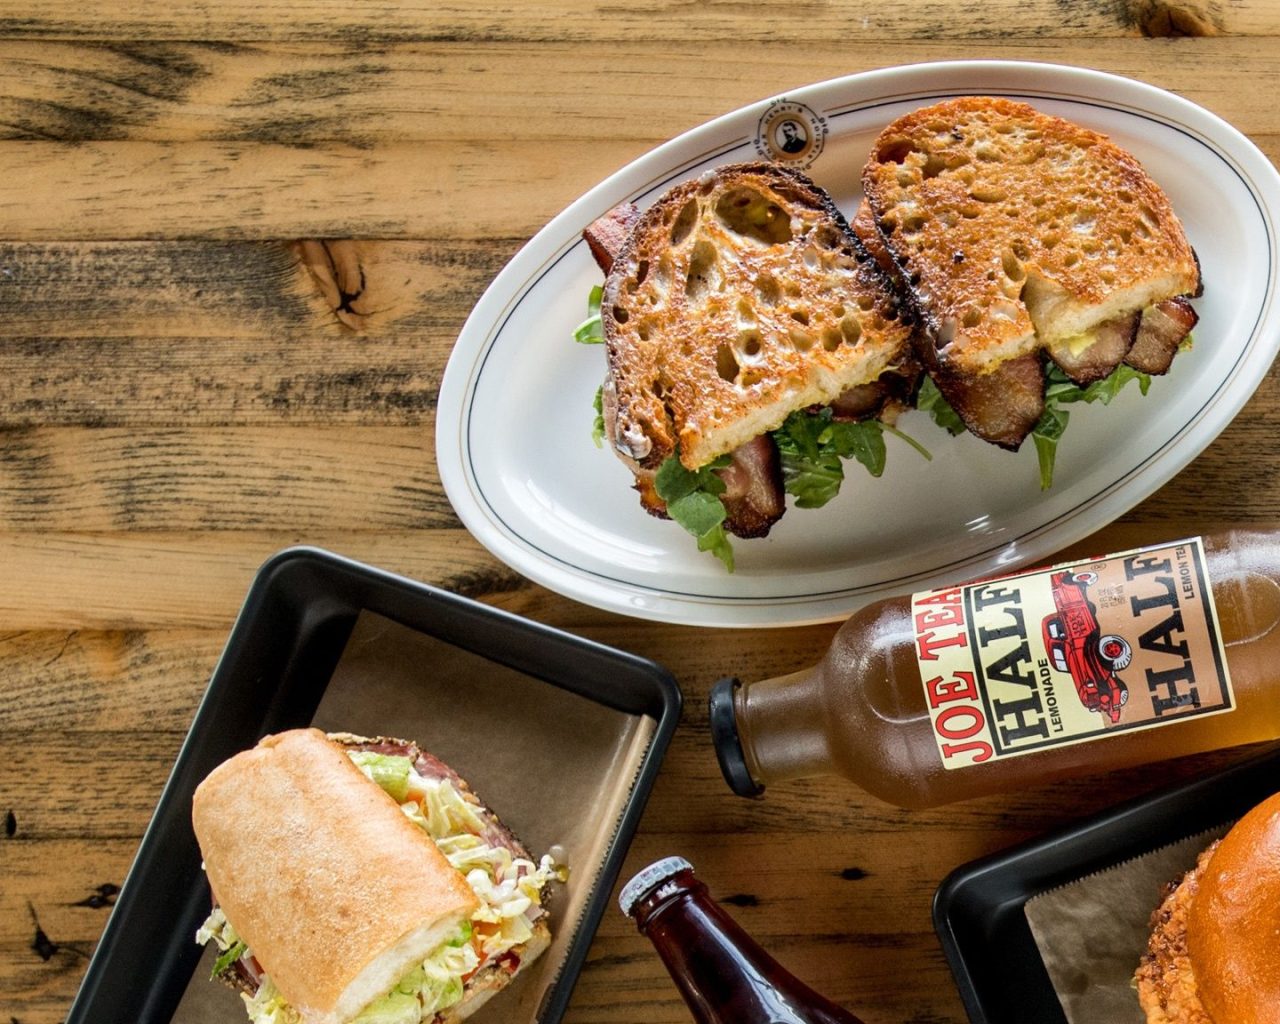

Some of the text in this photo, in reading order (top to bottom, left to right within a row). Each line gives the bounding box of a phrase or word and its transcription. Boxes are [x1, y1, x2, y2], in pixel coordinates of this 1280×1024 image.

[1123, 555, 1202, 717] HALF
[1178, 561, 1195, 600] LEMON
[914, 587, 994, 763] JOE TEA
[973, 585, 1051, 747] HALF
[1037, 657, 1064, 733] LEMONADE
